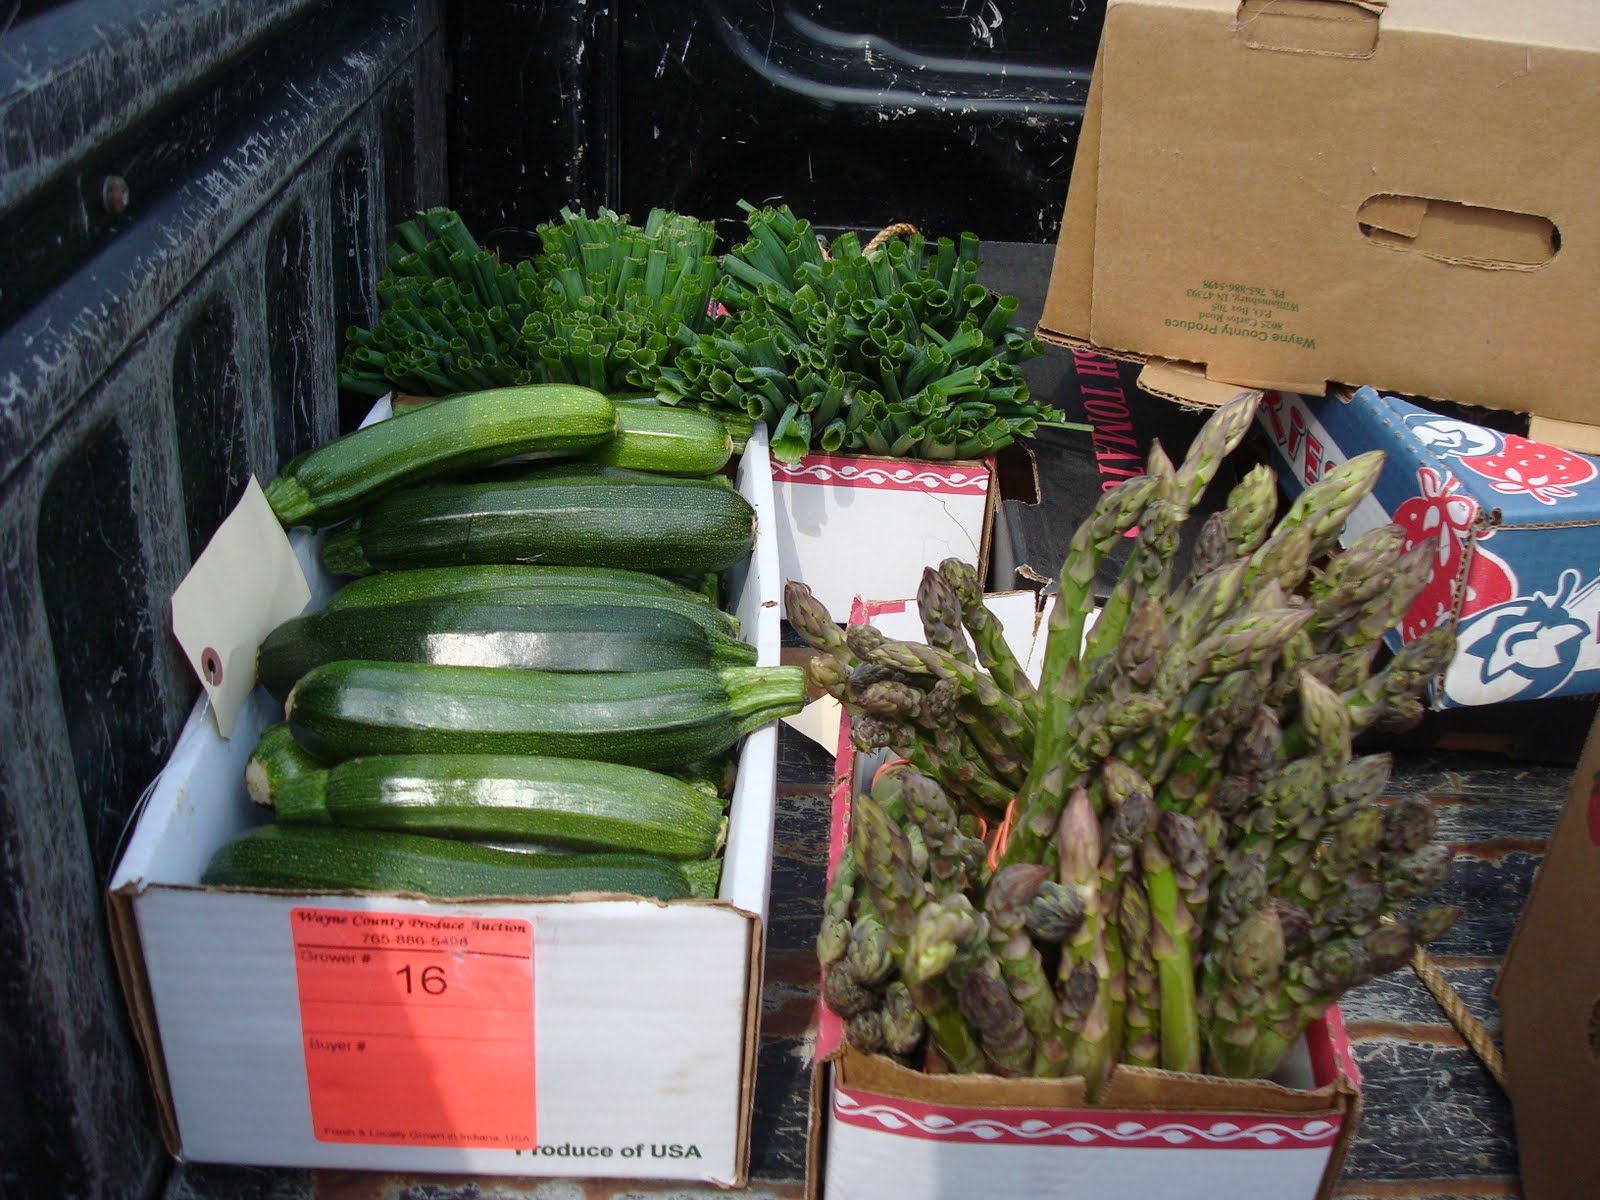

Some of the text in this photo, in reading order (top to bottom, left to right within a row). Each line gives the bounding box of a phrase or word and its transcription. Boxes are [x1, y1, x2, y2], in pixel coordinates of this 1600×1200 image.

[1231, 306, 1249, 315] Box
[1164, 318, 1316, 350] Wayne County Produce
[299, 912, 348, 925] Wayne
[352, 915, 405, 930] County
[409, 918, 464, 931] Produce
[301, 952, 356, 963] Grower
[396, 964, 448, 995] 16
[309, 1039, 351, 1052] Buyer
[620, 1143, 645, 1159] of
[651, 1144, 702, 1159] USA
